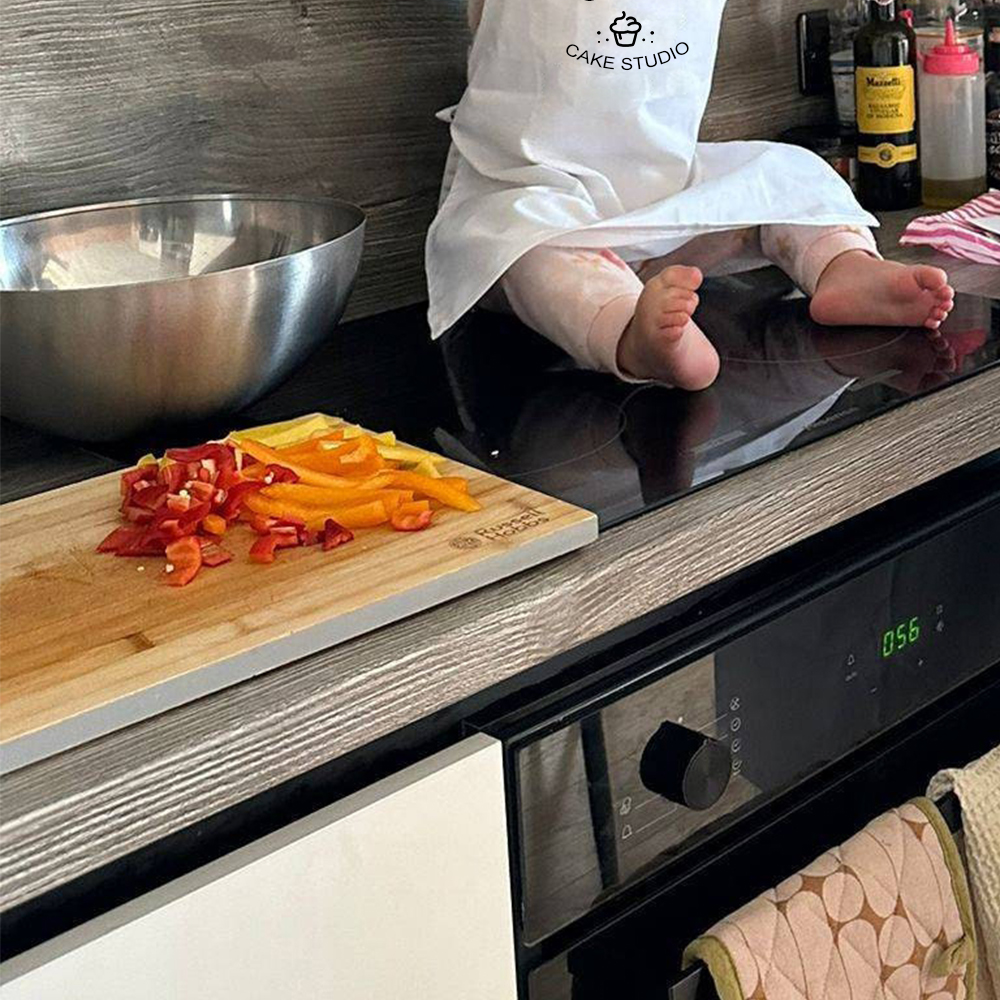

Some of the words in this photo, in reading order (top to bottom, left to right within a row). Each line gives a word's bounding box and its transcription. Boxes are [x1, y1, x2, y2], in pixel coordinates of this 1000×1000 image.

[565, 43, 616, 70] CAKE
[621, 41, 690, 71] STUDIO
[474, 507, 545, 538] Russell
[485, 516, 550, 541] Hobbs
